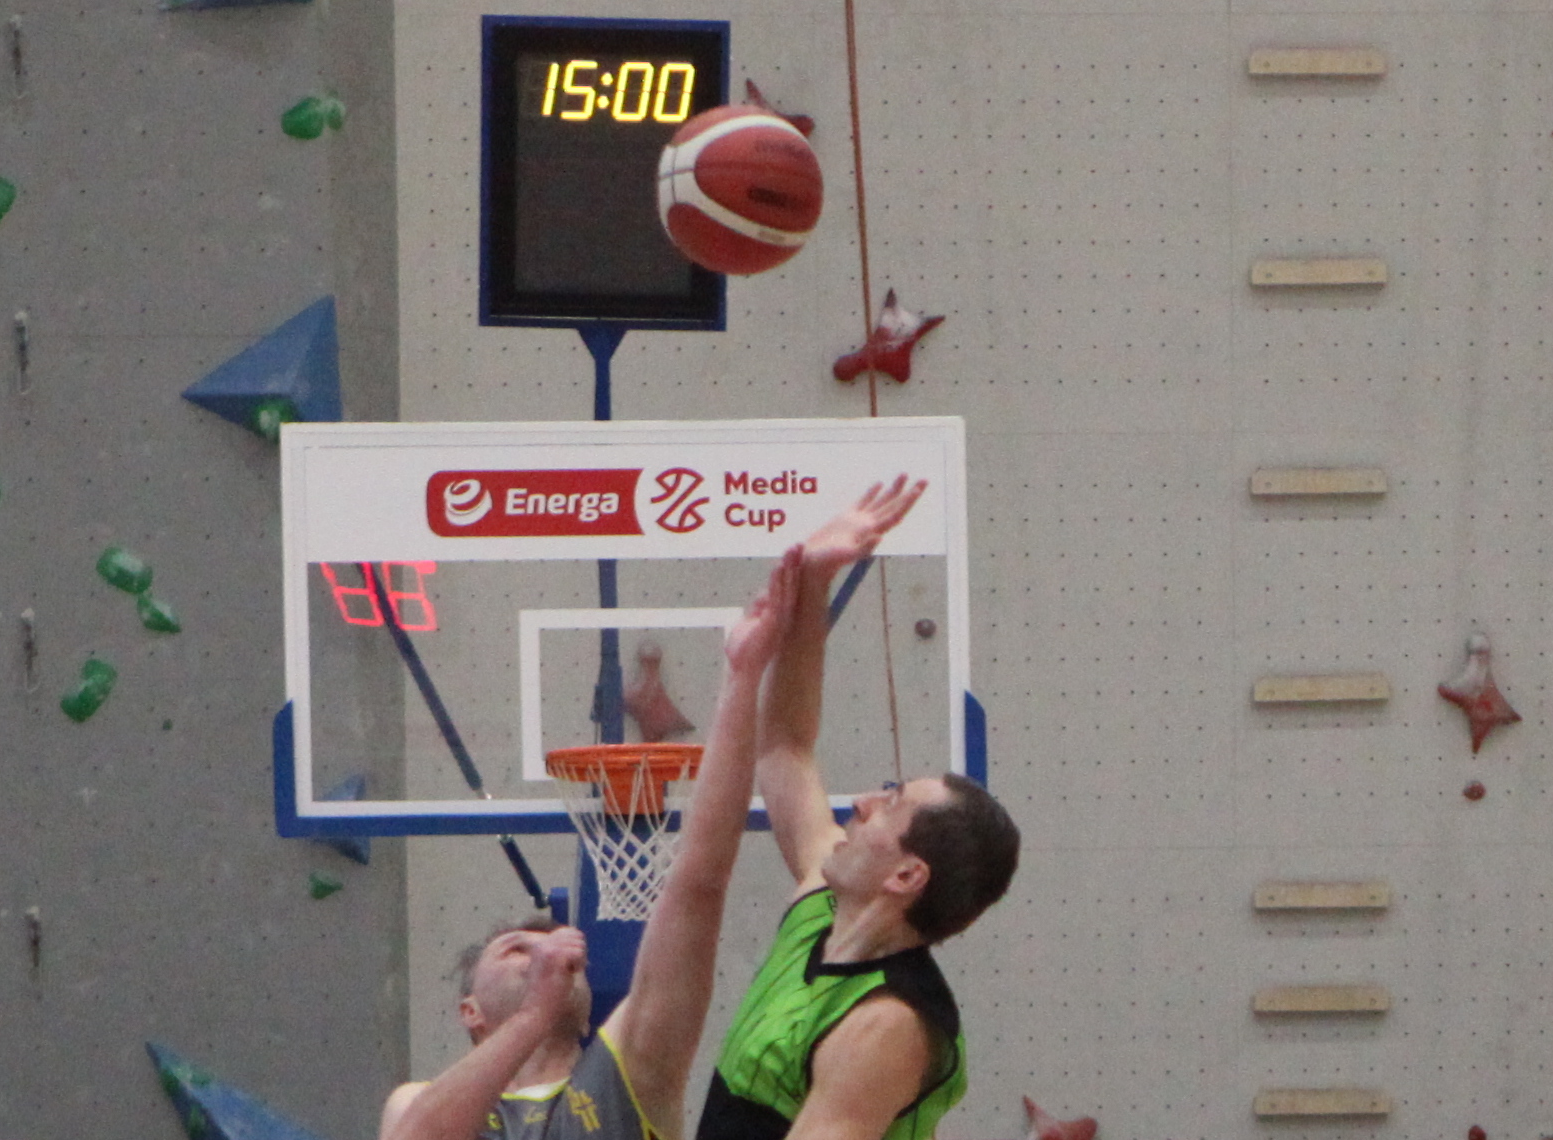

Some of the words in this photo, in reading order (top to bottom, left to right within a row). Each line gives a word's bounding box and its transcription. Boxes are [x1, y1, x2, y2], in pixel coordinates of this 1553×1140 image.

[542, 60, 696, 123] 15:00
[724, 470, 819, 495] Media
[505, 488, 620, 522] Energa
[724, 503, 787, 532] Cup
